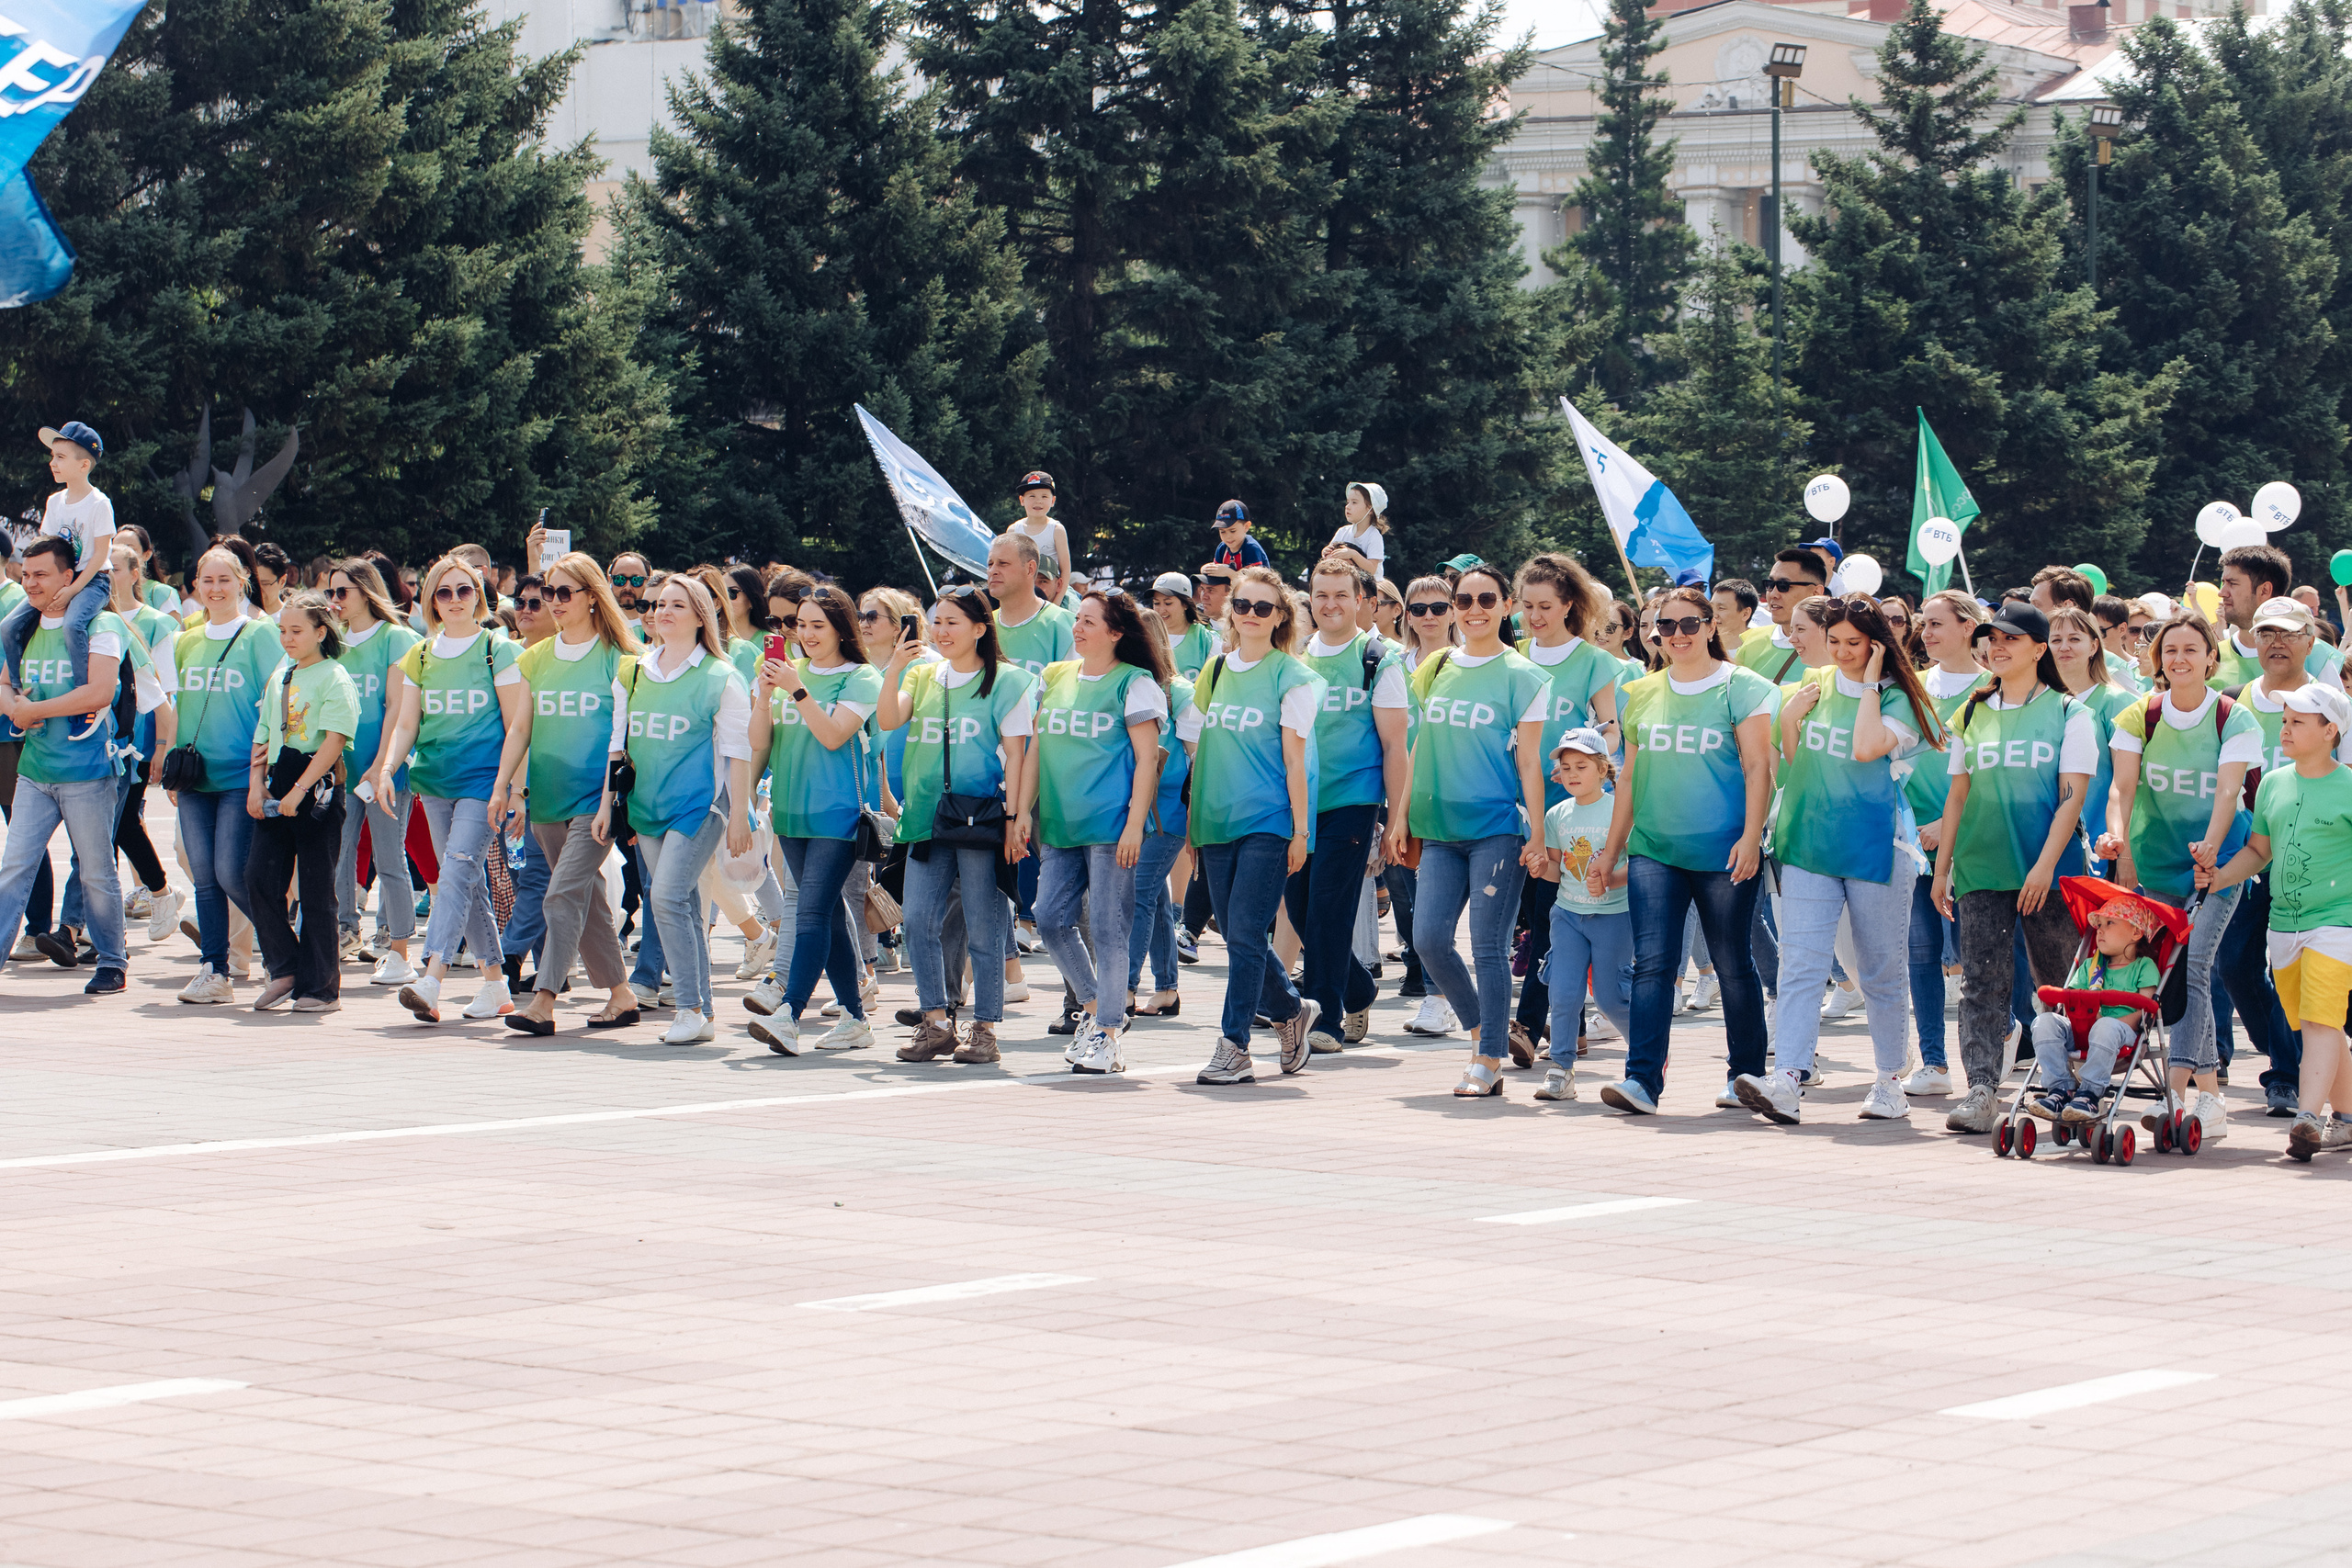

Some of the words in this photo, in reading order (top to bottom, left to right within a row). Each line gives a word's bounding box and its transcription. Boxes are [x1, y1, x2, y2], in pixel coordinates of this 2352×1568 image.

[1811, 482, 1830, 496] ВТБ
[2216, 506, 2235, 523] ВТБ
[2273, 511, 2291, 525] ВТБ
[546, 536, 564, 544] анки
[1933, 529, 1952, 543] ВТБ
[20, 659, 74, 684] БЕР
[351, 673, 380, 698] ЕР
[1322, 685, 1367, 712] ЕР
[421, 689, 489, 716] БЕР
[532, 690, 602, 717] БЕР
[1424, 696, 1496, 729] БЕР
[628, 710, 691, 741] БЕР
[1203, 702, 1264, 732] БЕР
[1798, 719, 1857, 761] БЕ
[1964, 739, 2054, 774] СБЕР
[2137, 761, 2218, 800] БЕР
[1558, 823, 1610, 838] Summer
